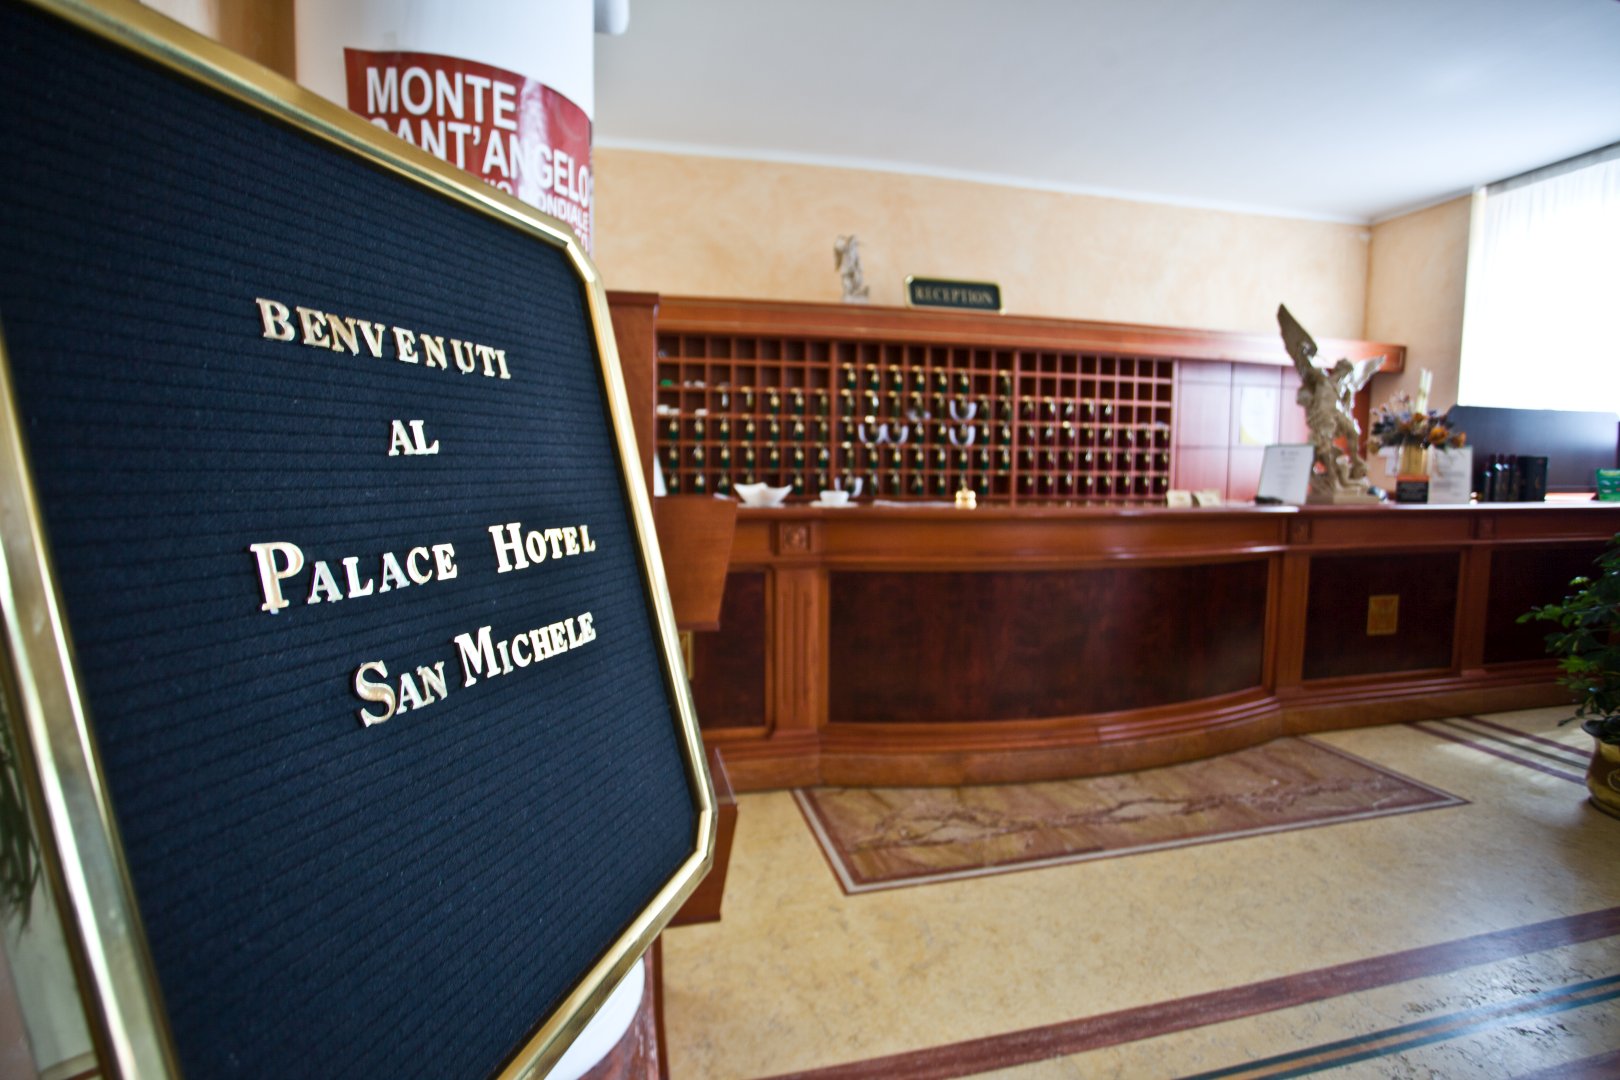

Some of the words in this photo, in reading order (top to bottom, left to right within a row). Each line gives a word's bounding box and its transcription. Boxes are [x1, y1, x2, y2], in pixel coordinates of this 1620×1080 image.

[366, 66, 517, 130] MONTE
[915, 286, 993, 304] RECEPTION
[256, 297, 511, 379] BENVENUTI
[389, 420, 439, 456] AL
[250, 542, 457, 614] PALACE
[489, 522, 596, 573] HOTEL
[355, 660, 448, 727] SAN
[454, 612, 597, 688] MICHELE
